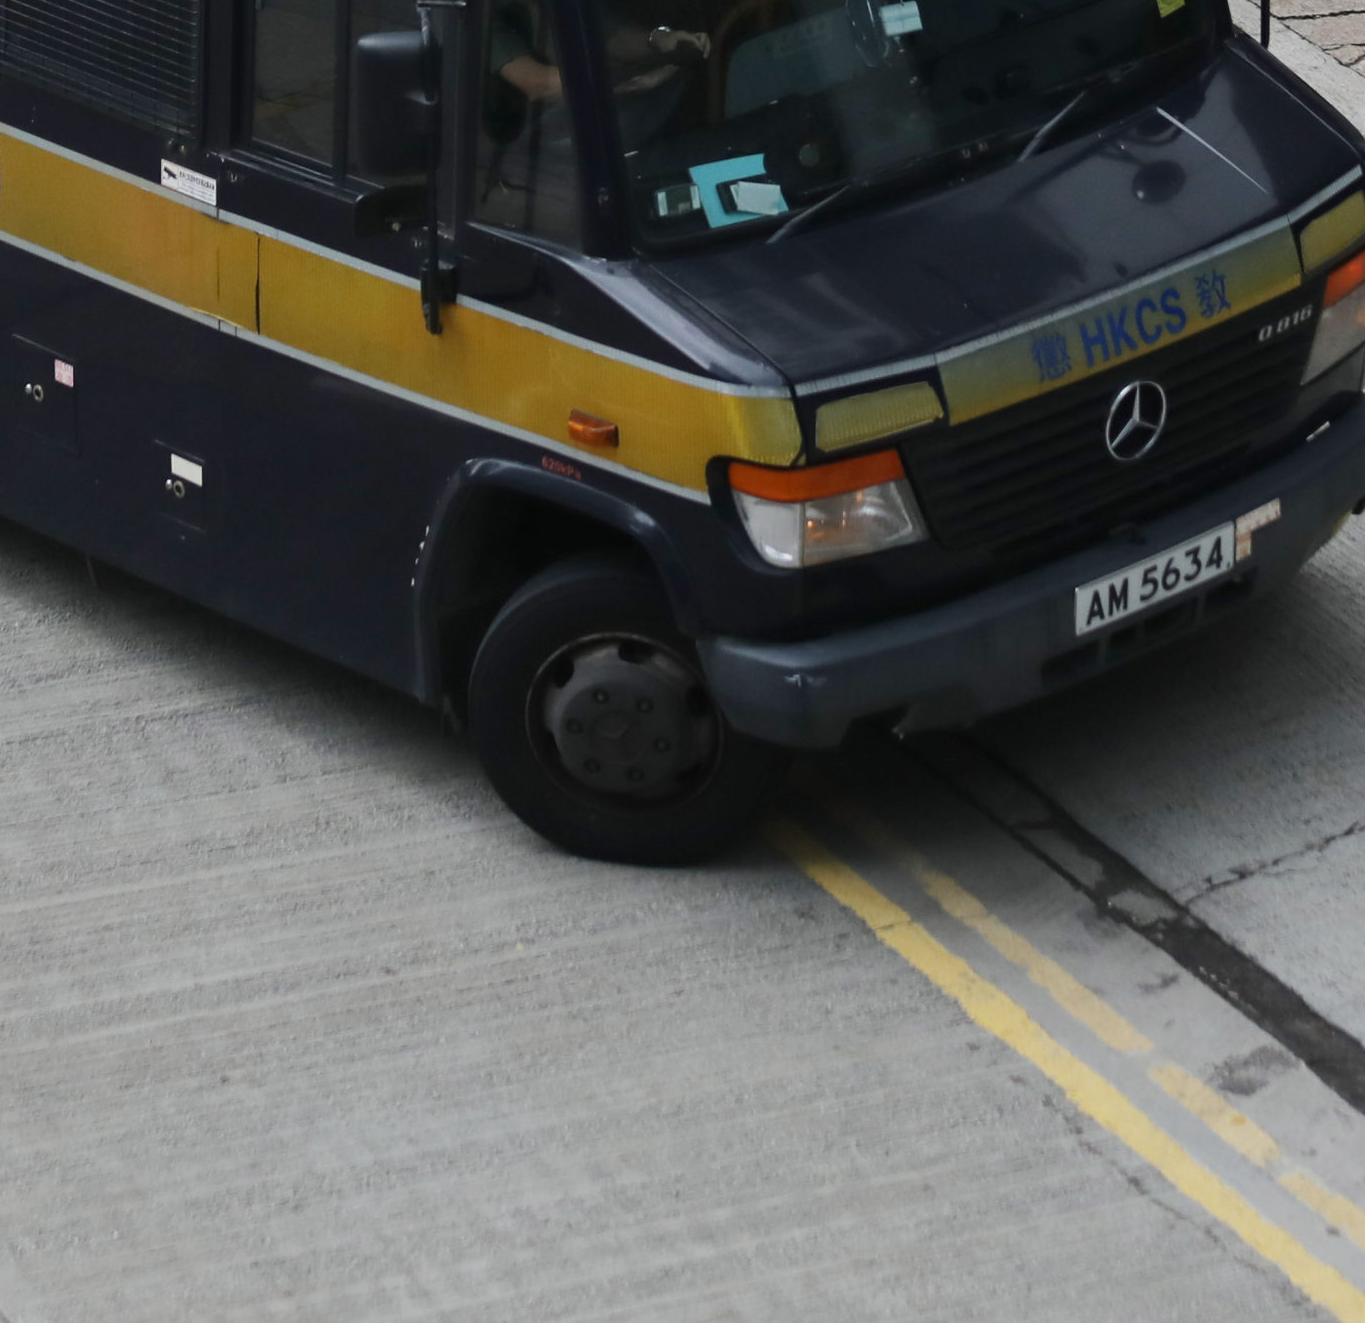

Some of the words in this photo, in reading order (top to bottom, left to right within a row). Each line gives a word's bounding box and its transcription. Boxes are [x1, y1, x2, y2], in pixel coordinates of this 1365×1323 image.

[1078, 287, 1189, 368] HKCS
[1086, 577, 1129, 626] AM
[1139, 535, 1225, 602] 5634
